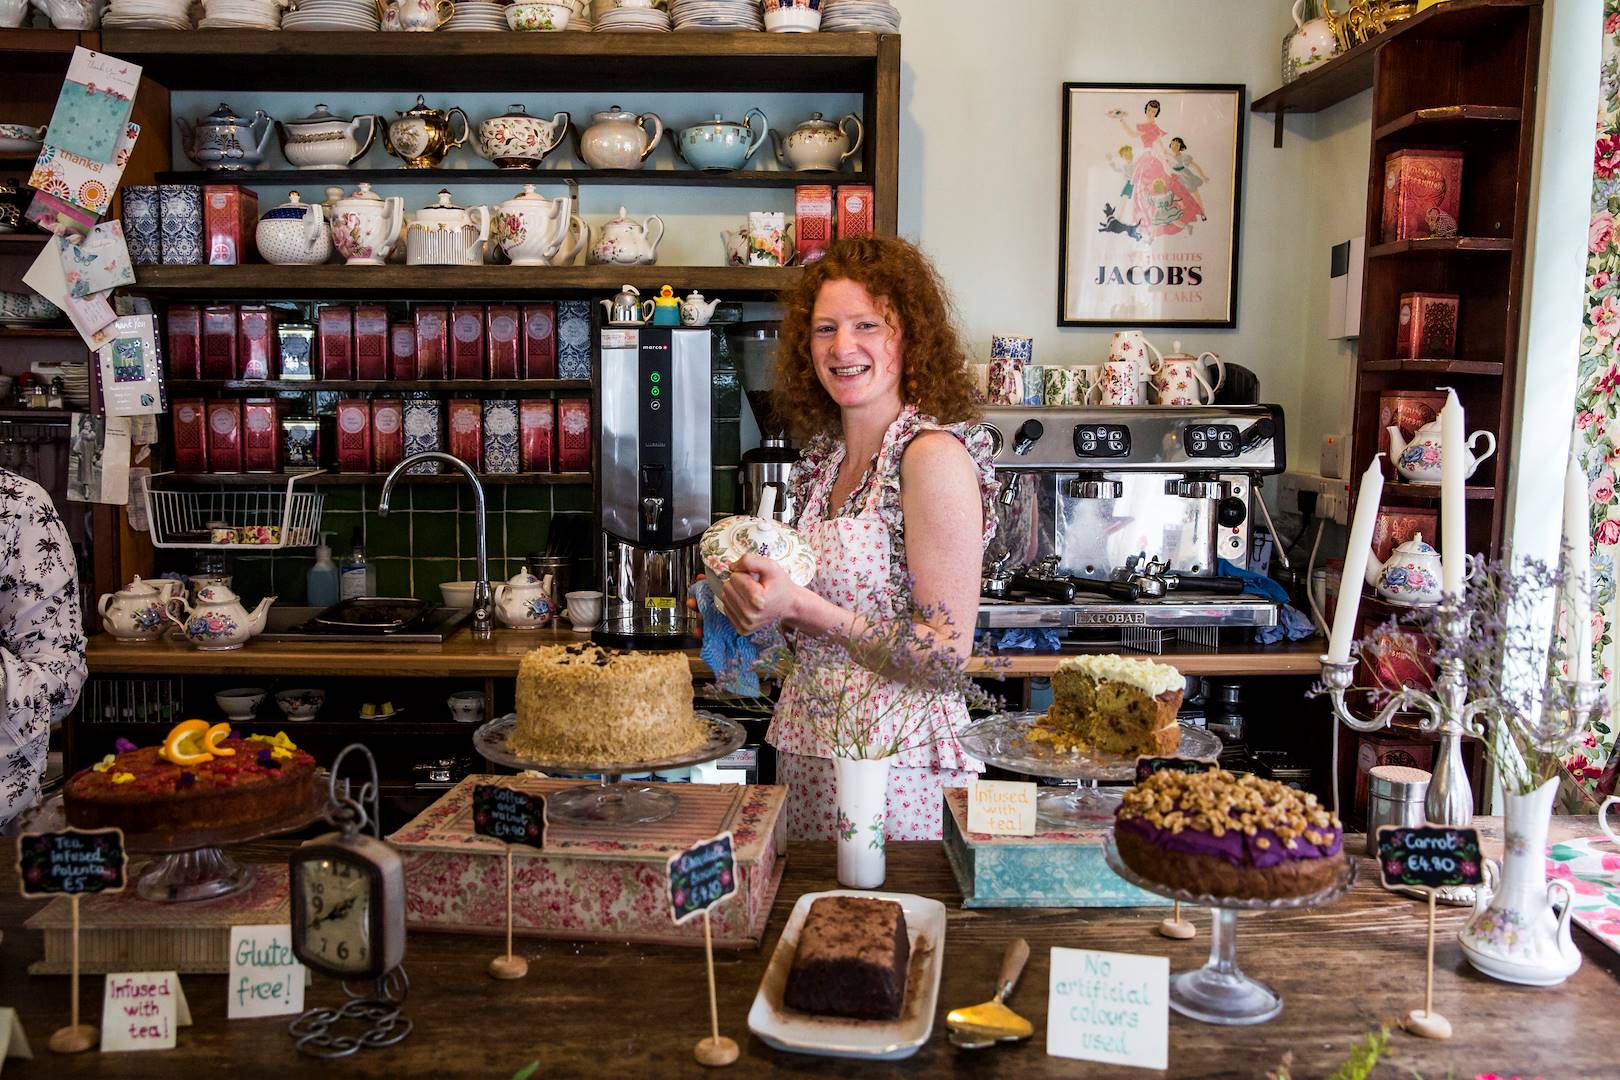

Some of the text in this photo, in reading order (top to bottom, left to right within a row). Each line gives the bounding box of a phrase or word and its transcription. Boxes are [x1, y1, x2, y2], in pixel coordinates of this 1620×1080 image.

[1095, 265, 1203, 286] JACOB'S
[1078, 613, 1143, 623] EXPOBAR
[55, 838, 83, 849] Tea
[1404, 832, 1457, 850] Carrot
[1407, 854, 1456, 872] €4.90
[1084, 953, 1112, 978] No
[110, 978, 171, 998] Infused
[236, 974, 292, 1006] free!
[1055, 979, 1152, 1006] artificial
[123, 1001, 160, 1016] with
[1070, 1001, 1139, 1029] colours
[128, 1016, 169, 1039] tea!
[1082, 1030, 1131, 1056] used
